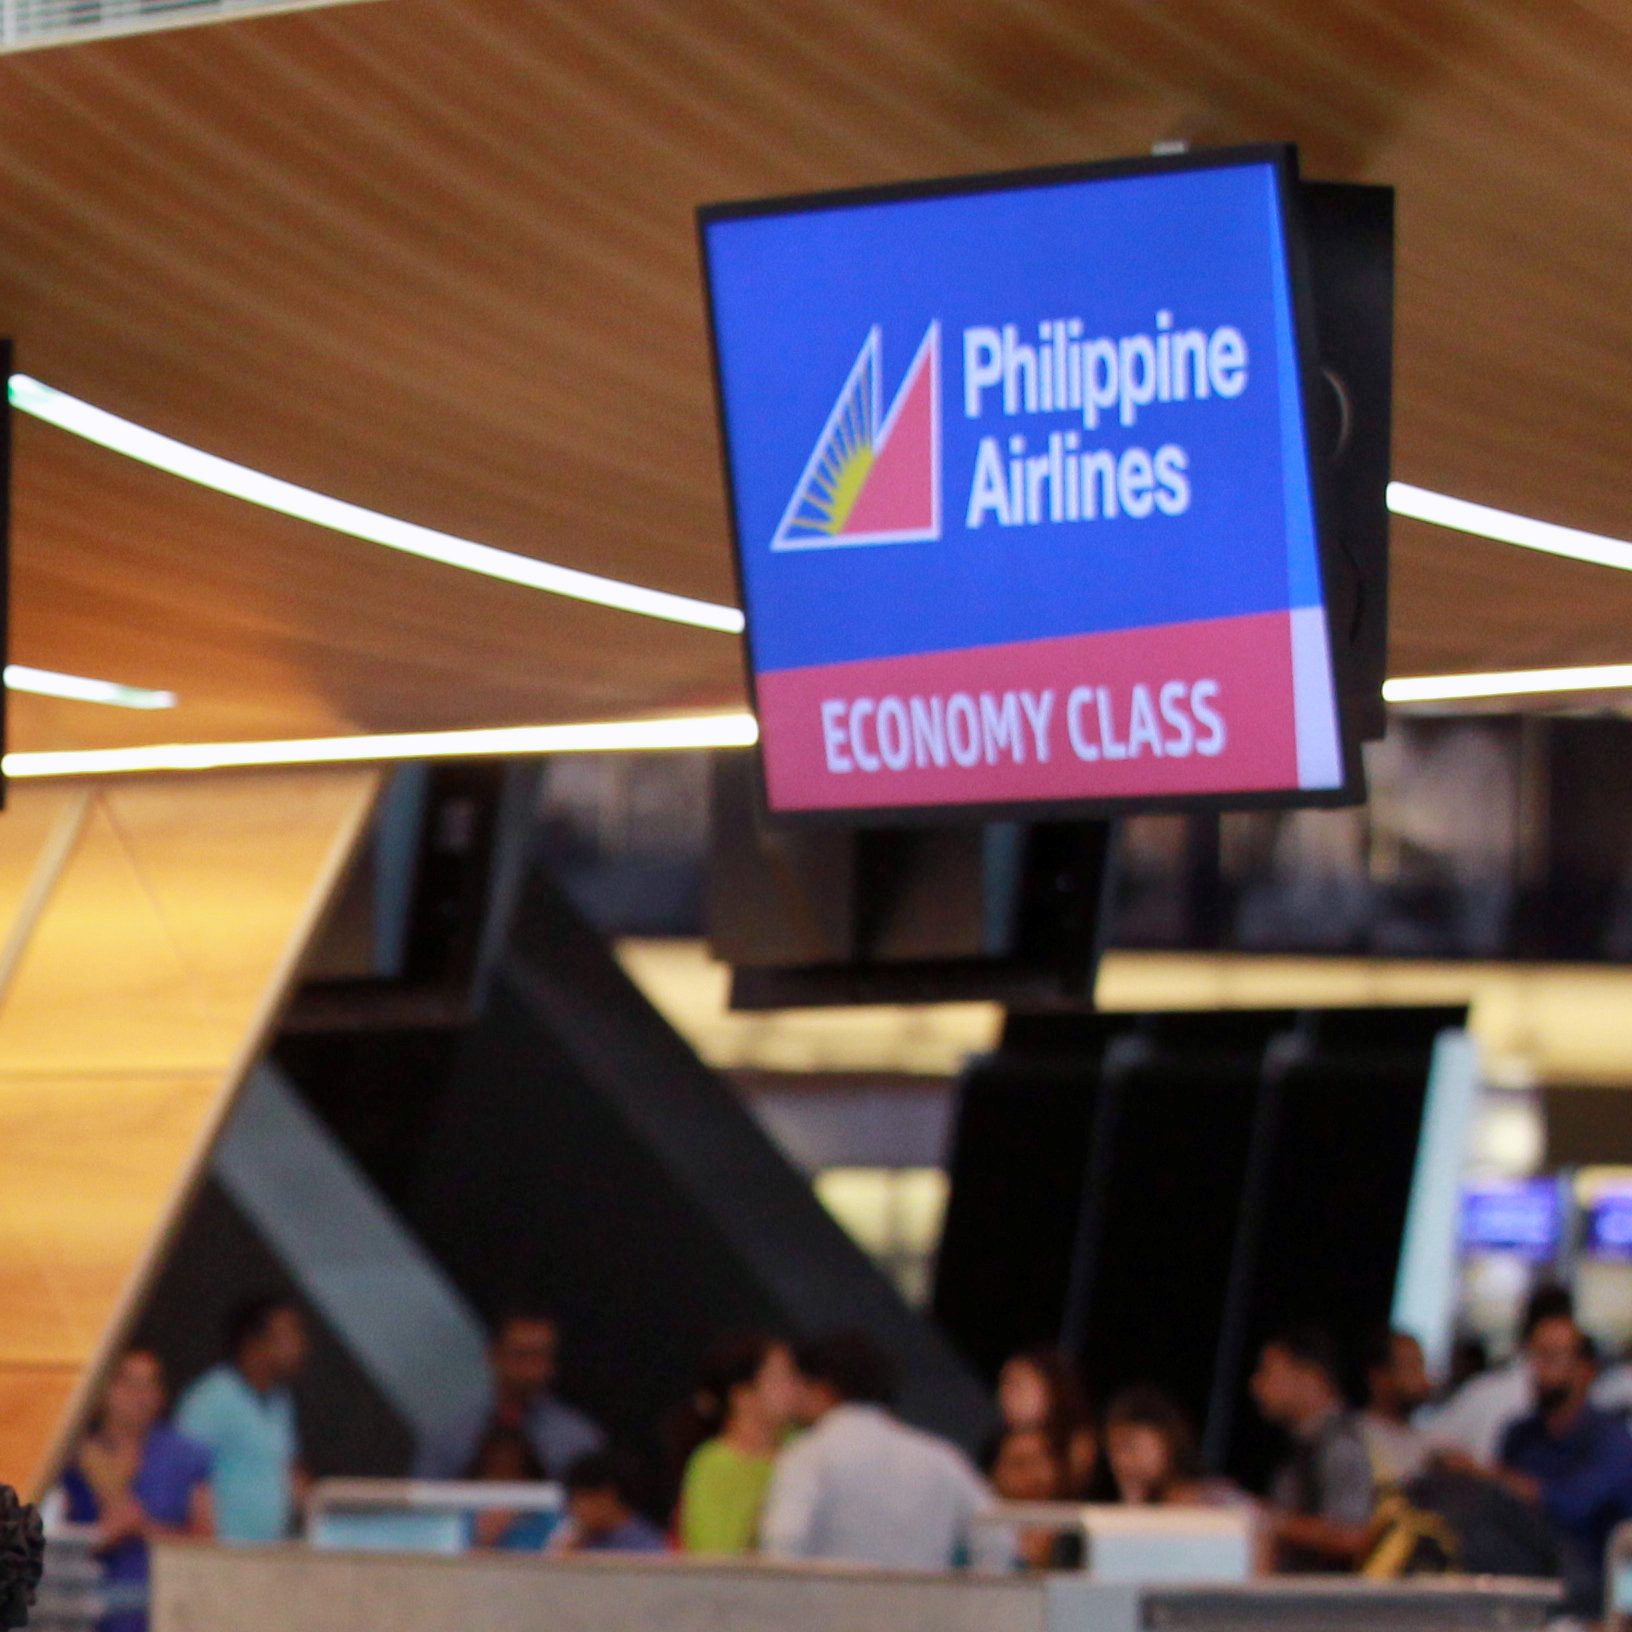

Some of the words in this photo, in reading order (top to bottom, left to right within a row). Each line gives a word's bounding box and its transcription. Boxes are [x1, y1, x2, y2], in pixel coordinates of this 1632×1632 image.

[963, 309, 1248, 430] Philippine
[965, 431, 1191, 529] Airlines
[821, 690, 1055, 773] ECONOMY
[1067, 679, 1227, 762] CLASS
